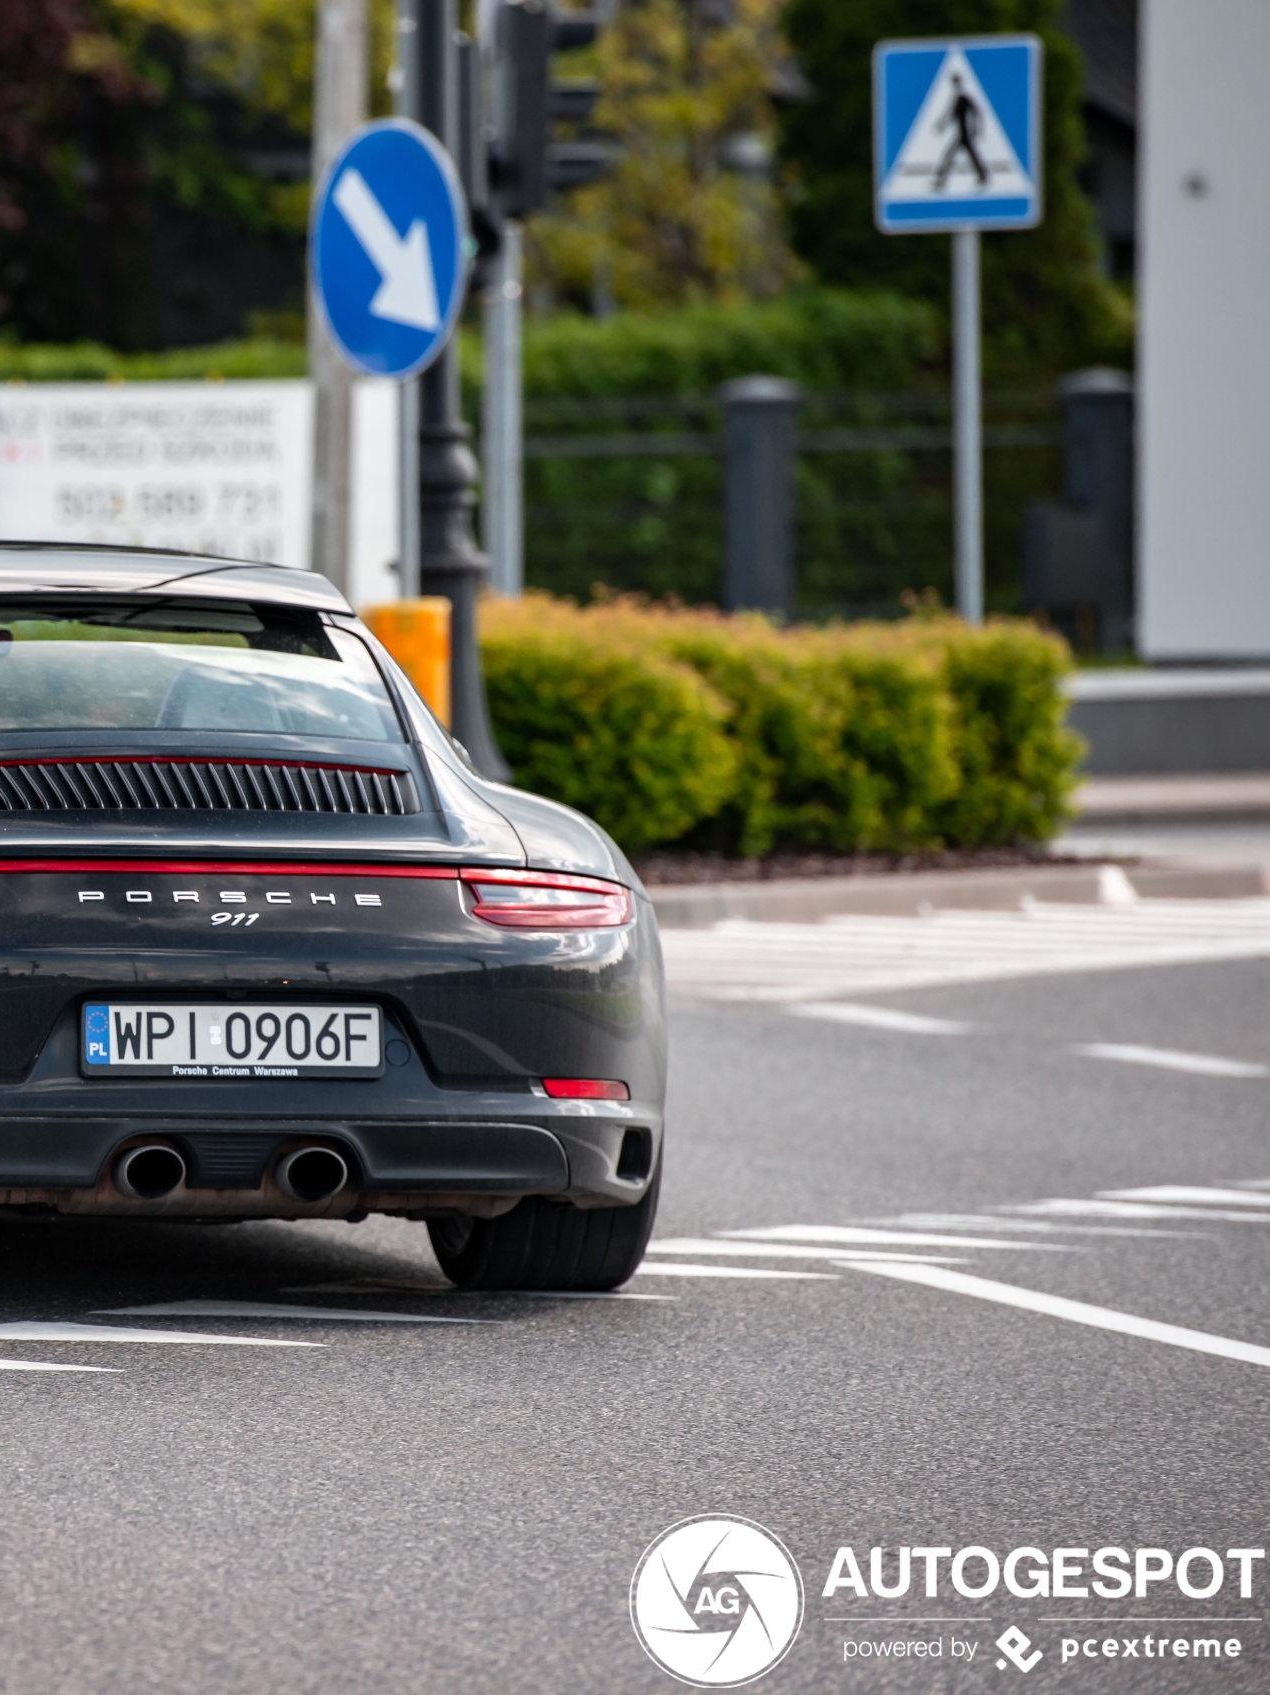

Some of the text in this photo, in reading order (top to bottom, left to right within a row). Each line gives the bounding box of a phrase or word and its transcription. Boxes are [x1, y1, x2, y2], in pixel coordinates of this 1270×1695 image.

[78, 890, 383, 907] PORSCHE
[210, 912, 260, 927] 911
[114, 1011, 372, 1062] WPI 0906F
[89, 1042, 108, 1057] PL
[172, 1065, 298, 1077] Porsche Centrum Warszawa
